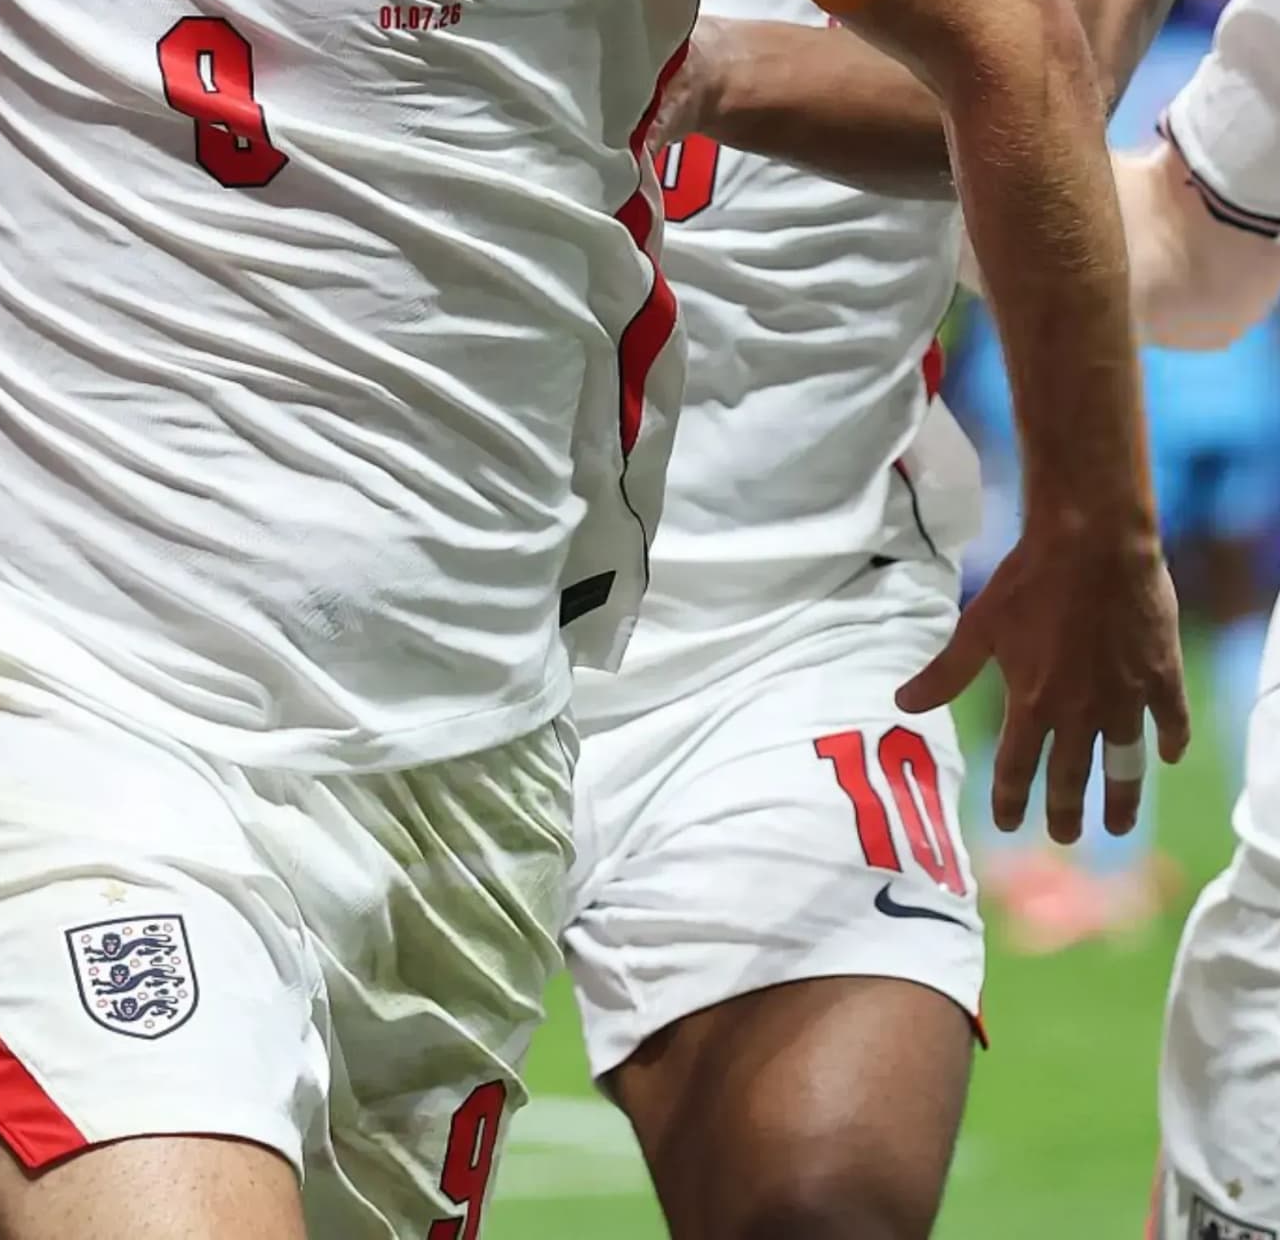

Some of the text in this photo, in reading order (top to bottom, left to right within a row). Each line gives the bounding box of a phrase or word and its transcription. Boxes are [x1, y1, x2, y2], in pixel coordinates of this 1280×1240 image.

[380, 3, 462, 31] 01.07.26
[813, 724, 968, 898] 10
[426, 1078, 507, 1240] 9
